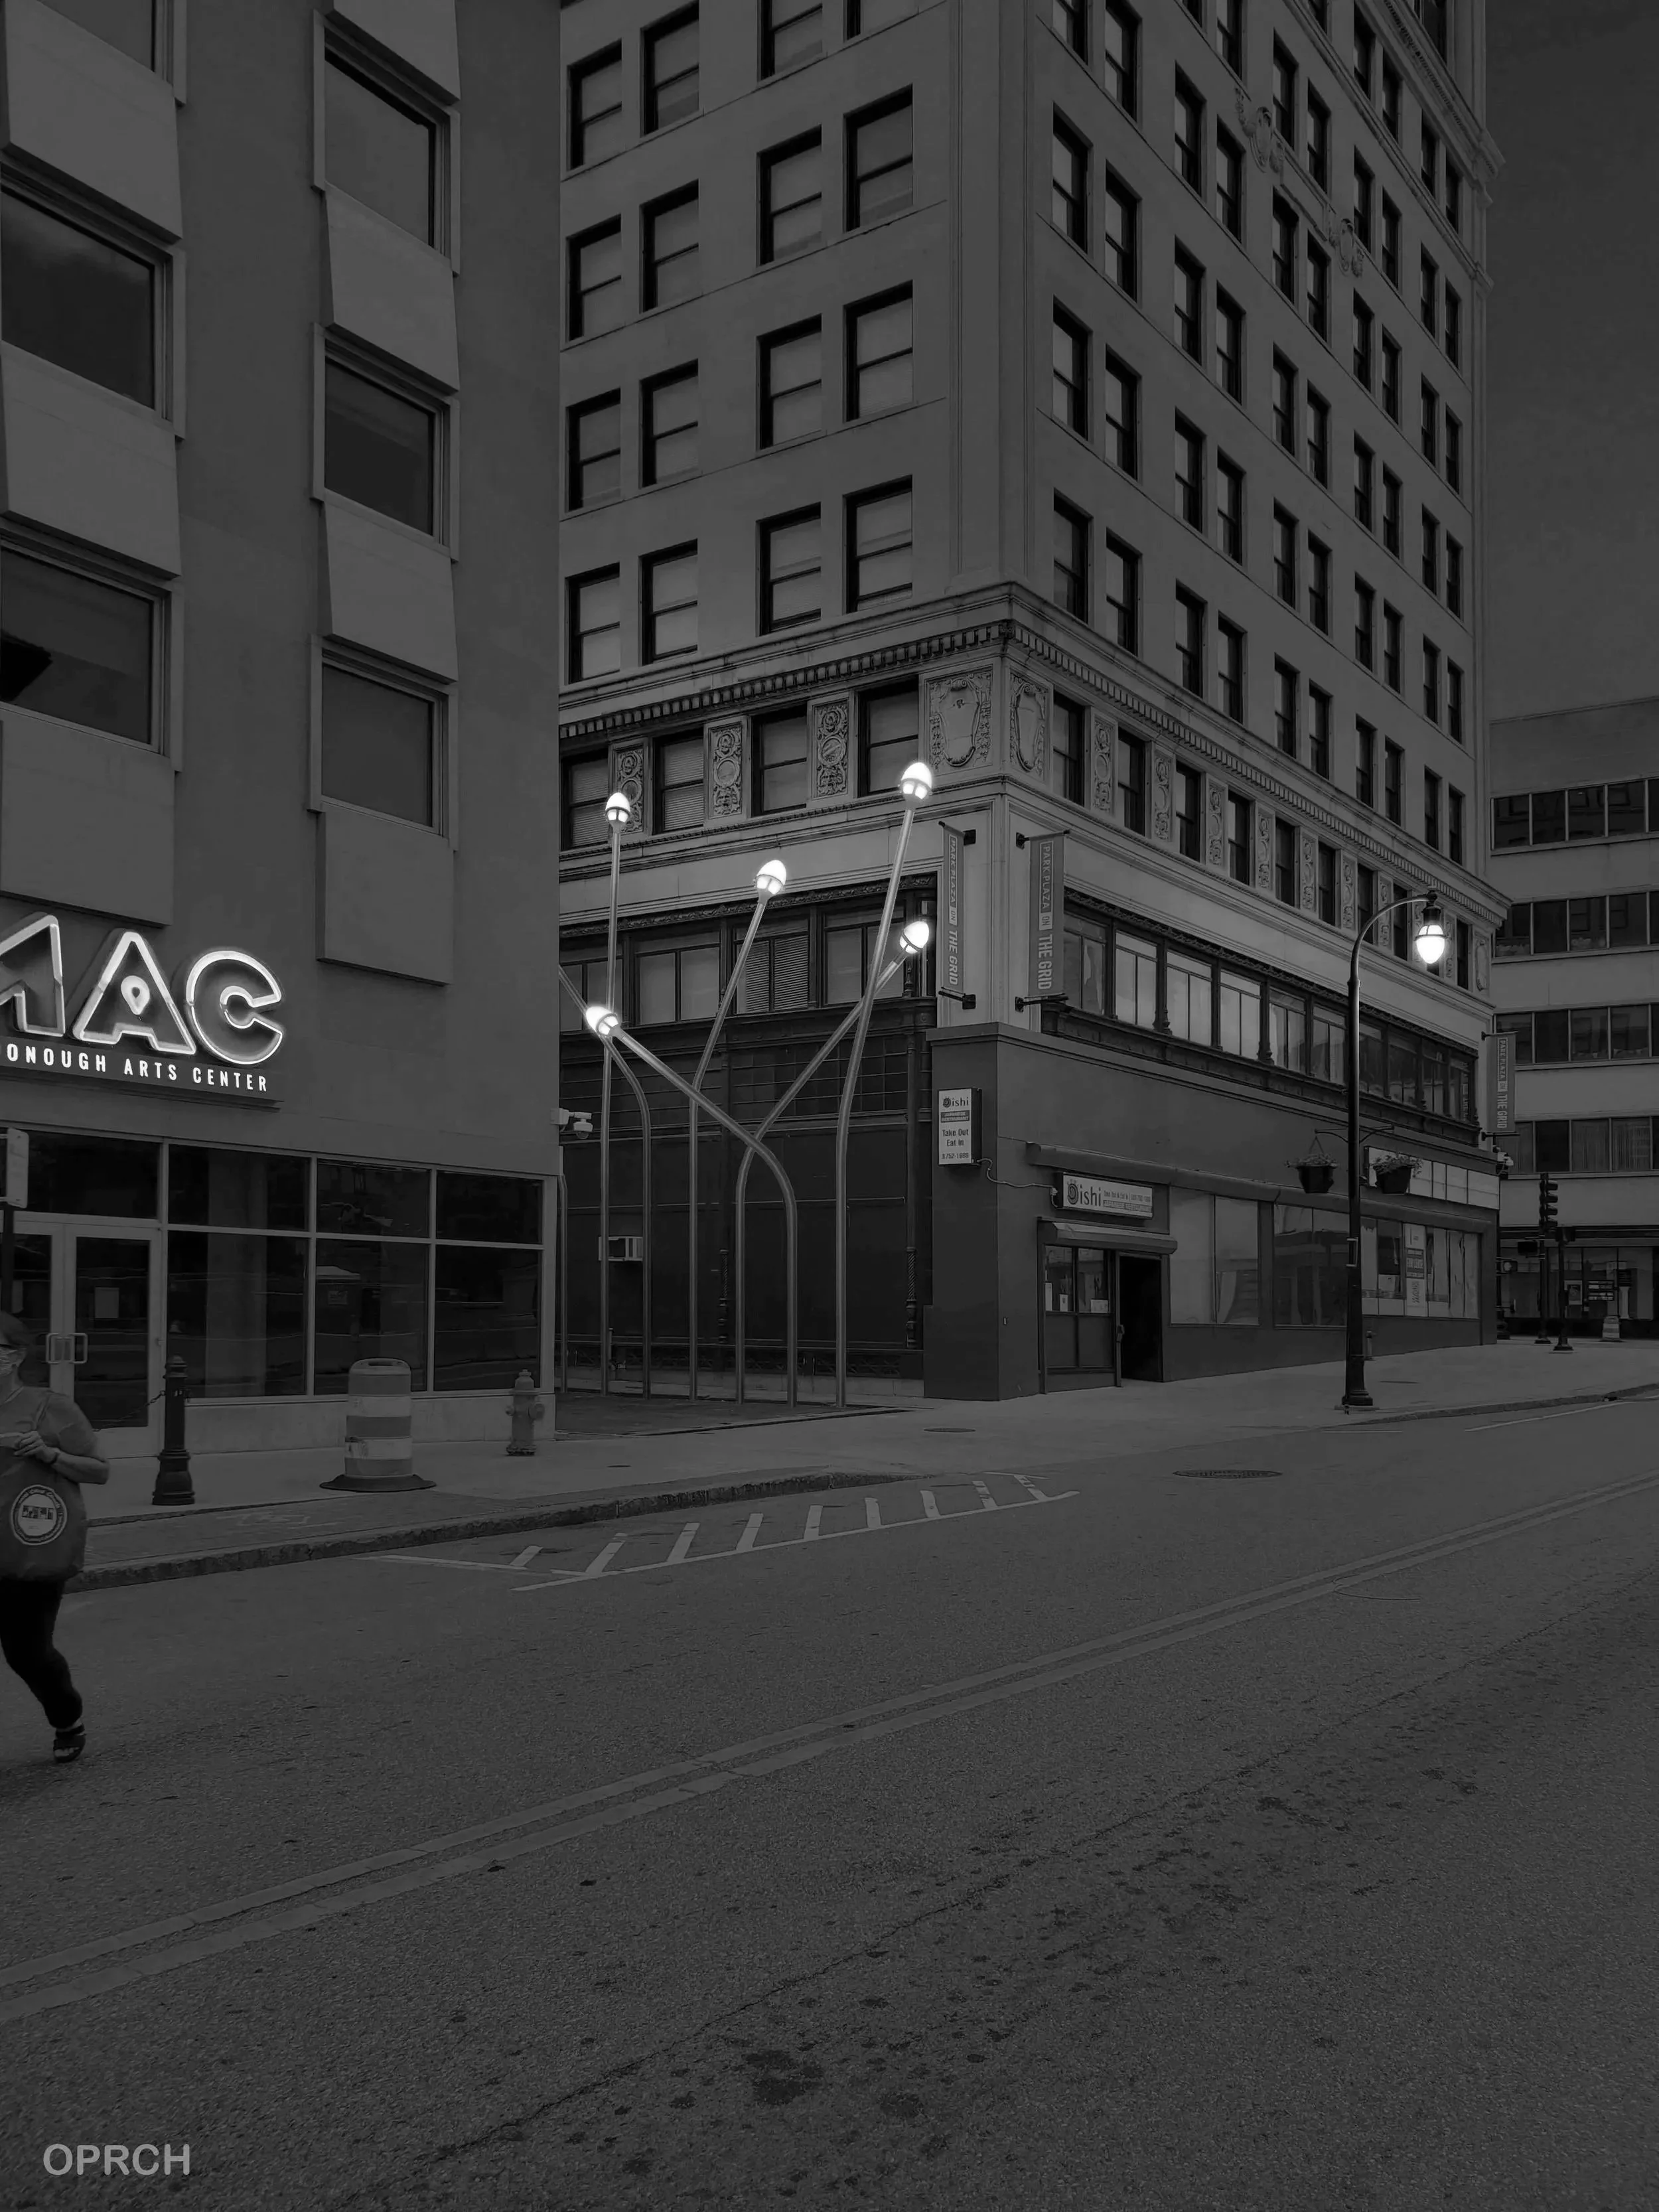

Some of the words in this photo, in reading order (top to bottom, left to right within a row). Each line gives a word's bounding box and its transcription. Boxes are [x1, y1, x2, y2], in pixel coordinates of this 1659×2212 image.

[1043, 846, 1051, 873] PARK
[1042, 875, 1050, 909] PLAZA
[950, 909, 957, 921] ON
[1042, 915, 1050, 926] ON
[949, 930, 958, 954] THE
[1039, 934, 1052, 958] THE
[948, 956, 958, 986] GRID
[1038, 960, 1052, 990] GRID
[7, 1043, 107, 1072] ONOUGH
[124, 1058, 177, 1080] ARTS
[192, 1067, 267, 1092] CENTER
[1497, 1094, 1508, 1110] THE
[1497, 1110, 1508, 1129] GRID
